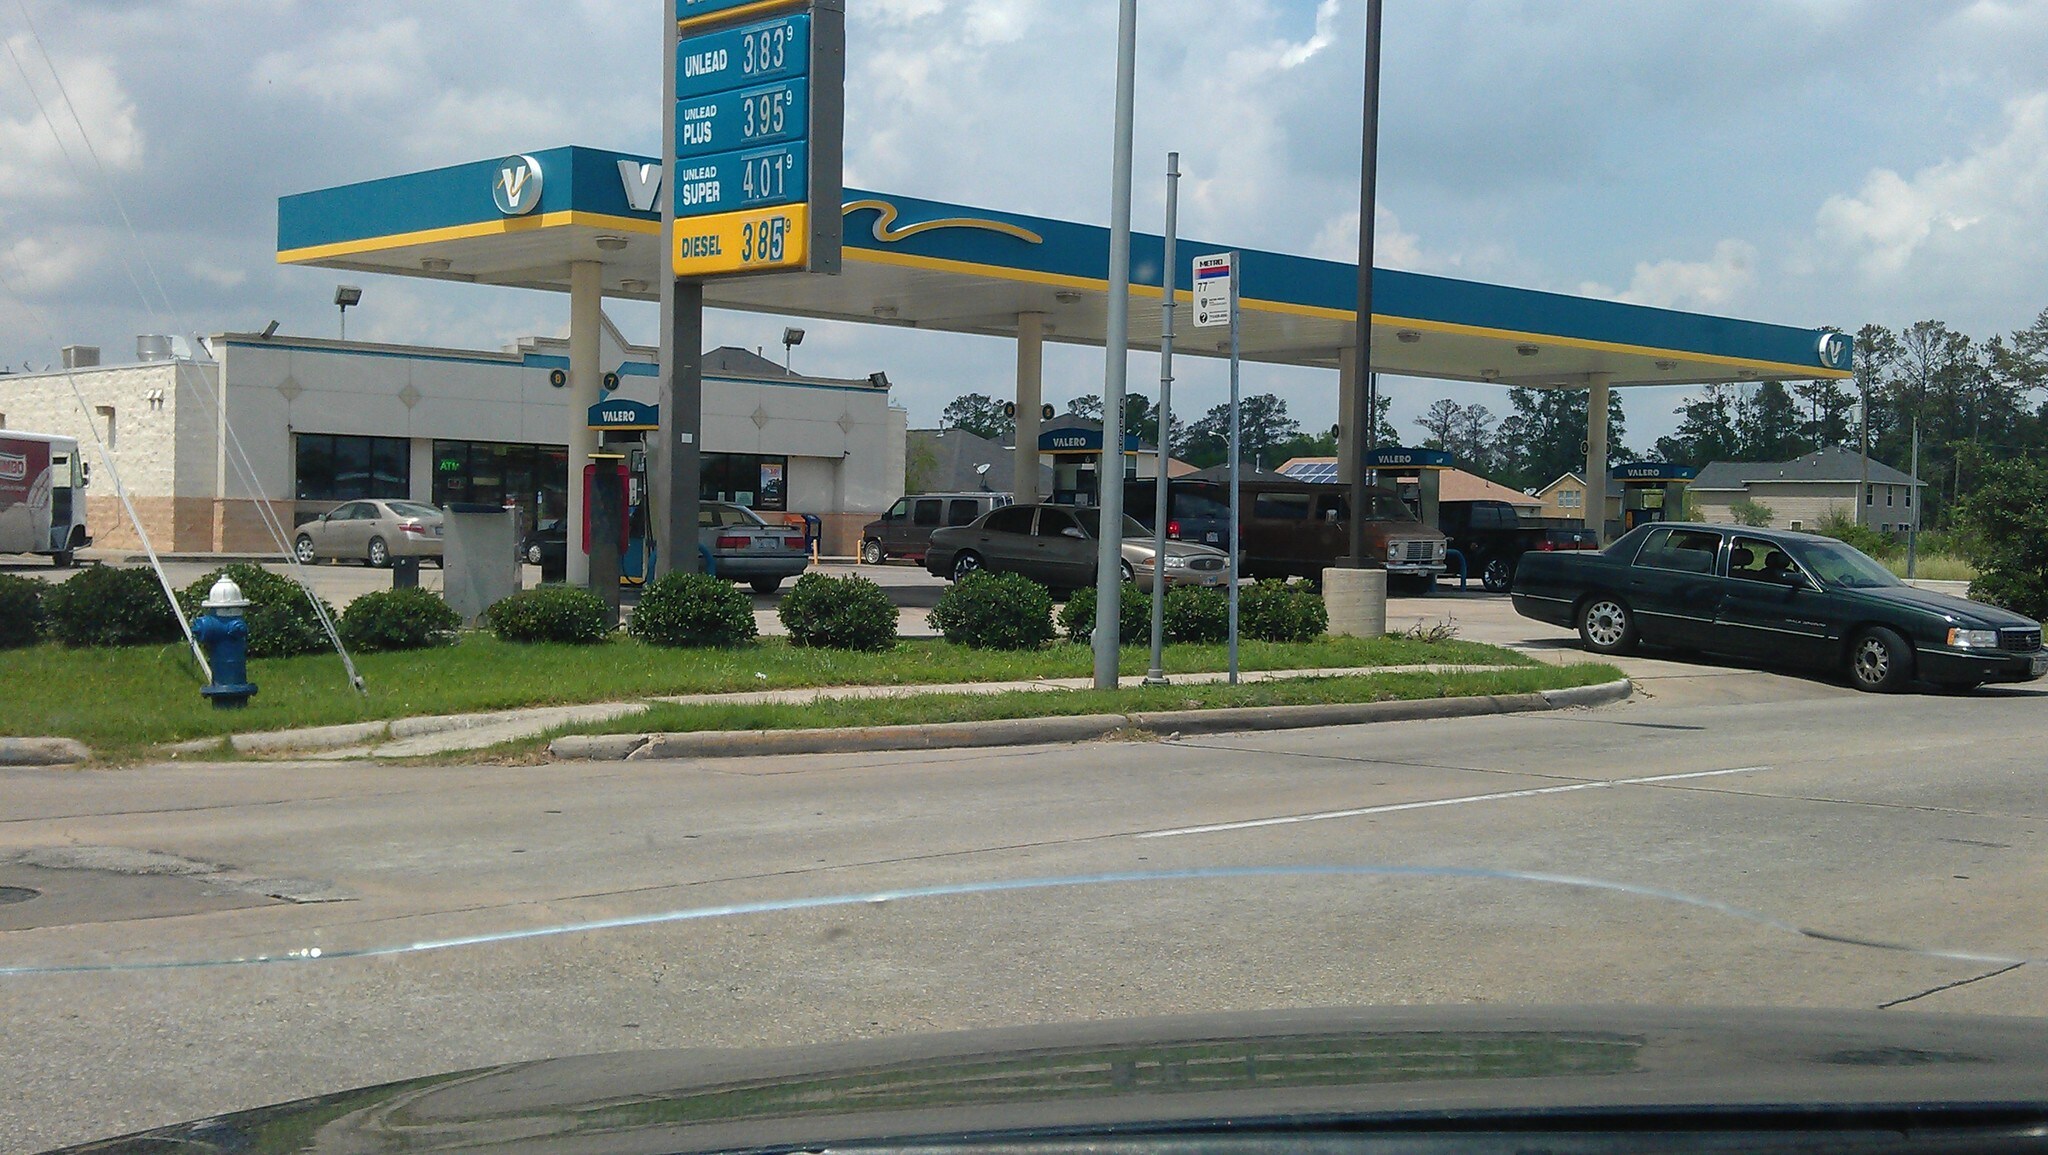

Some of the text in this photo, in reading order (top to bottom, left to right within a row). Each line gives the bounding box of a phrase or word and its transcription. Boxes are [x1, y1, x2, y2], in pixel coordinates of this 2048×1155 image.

[685, 49, 728, 78] UNLEAD
[684, 104, 717, 121] UNLEAD
[684, 121, 712, 145] PLUS
[743, 92, 784, 138] 3.95
[683, 166, 717, 181] UNLEAD
[682, 181, 721, 206] SUPER
[743, 155, 784, 199] 4.01
[682, 235, 722, 259] DIESEL
[1200, 259, 1223, 267] METRO
[1198, 282, 1207, 292] 77
[608, 377, 614, 386] 7
[602, 410, 635, 422] VALERO
[1053, 437, 1086, 447] VALERO
[1378, 454, 1412, 464] VALERO
[440, 461, 460, 471] ATM
[1627, 468, 1660, 477] VALERO
